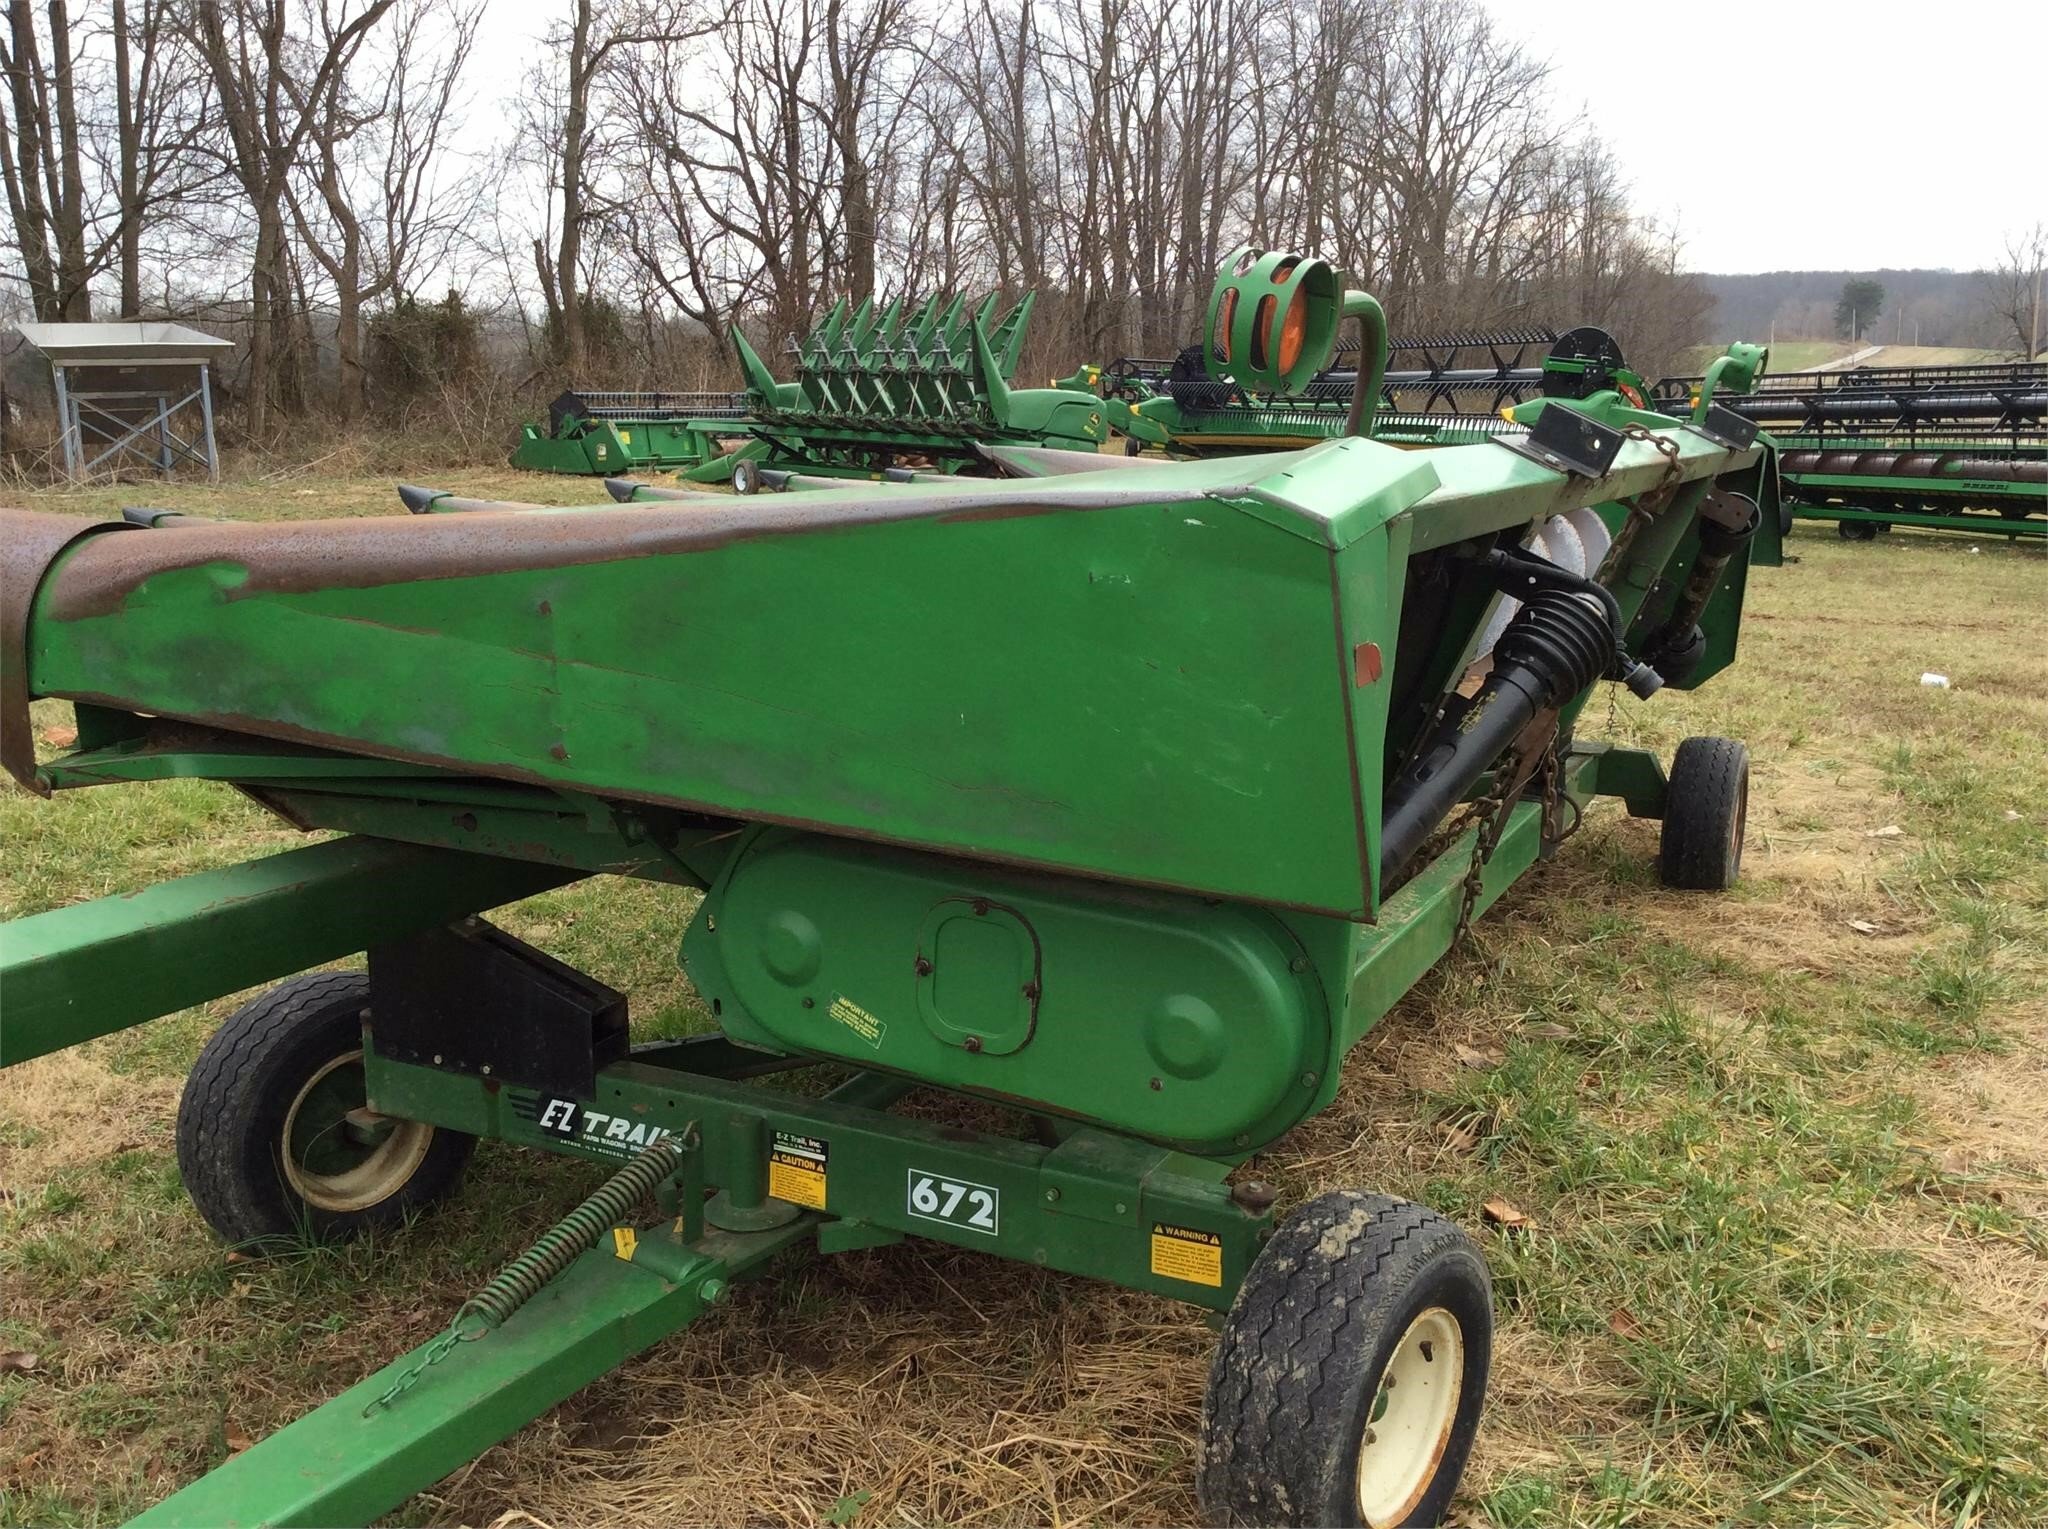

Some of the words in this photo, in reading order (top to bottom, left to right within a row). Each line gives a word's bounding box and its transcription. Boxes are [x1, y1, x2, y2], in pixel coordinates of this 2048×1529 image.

[838, 996, 879, 1027] IMPORTANT
[629, 1144, 646, 1153] SINC
[776, 1132, 789, 1141] E-Z
[790, 1135, 807, 1147] Trail,
[808, 1139, 823, 1149] Inc.
[781, 1154, 816, 1171] CAUTION
[912, 1177, 994, 1229] 672
[1165, 1226, 1209, 1242] WARNING
